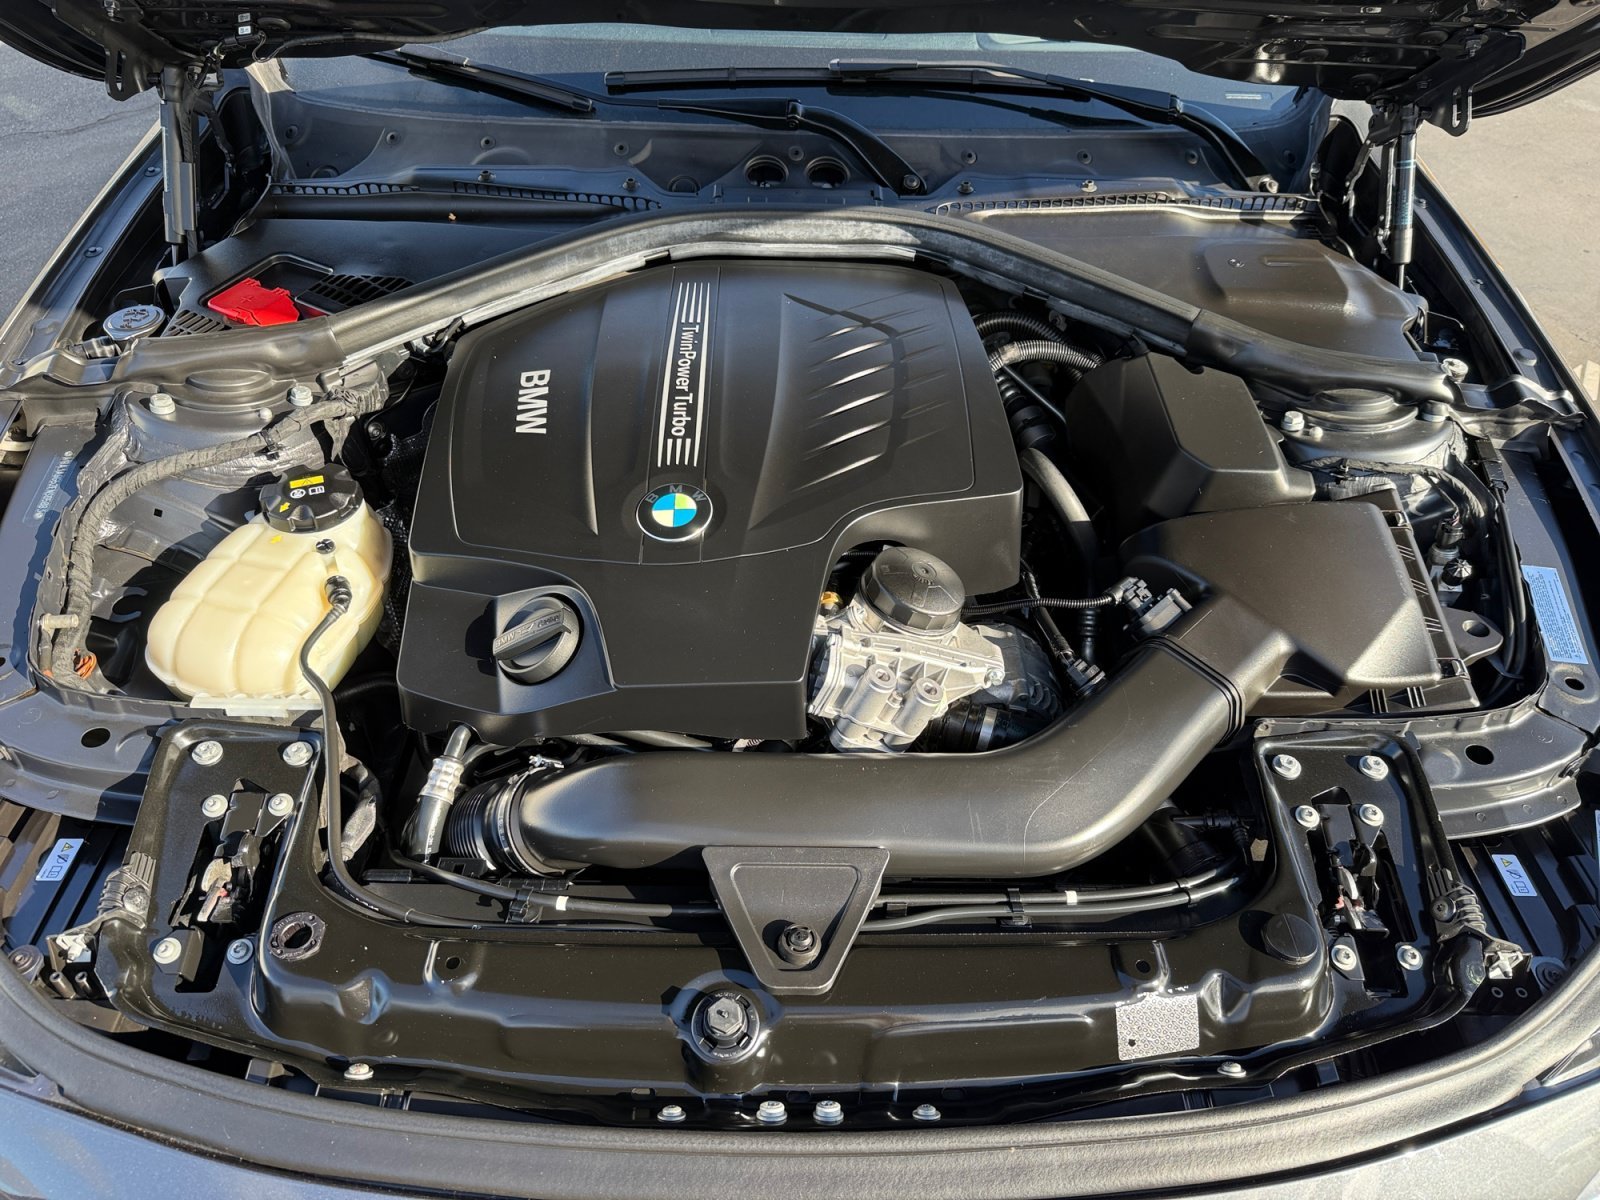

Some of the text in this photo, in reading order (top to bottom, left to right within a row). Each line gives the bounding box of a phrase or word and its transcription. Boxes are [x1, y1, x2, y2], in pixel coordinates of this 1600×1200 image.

[515, 369, 551, 434] BMW
[671, 324, 699, 437] TwinPower Turbo
[645, 484, 706, 504] BMW
